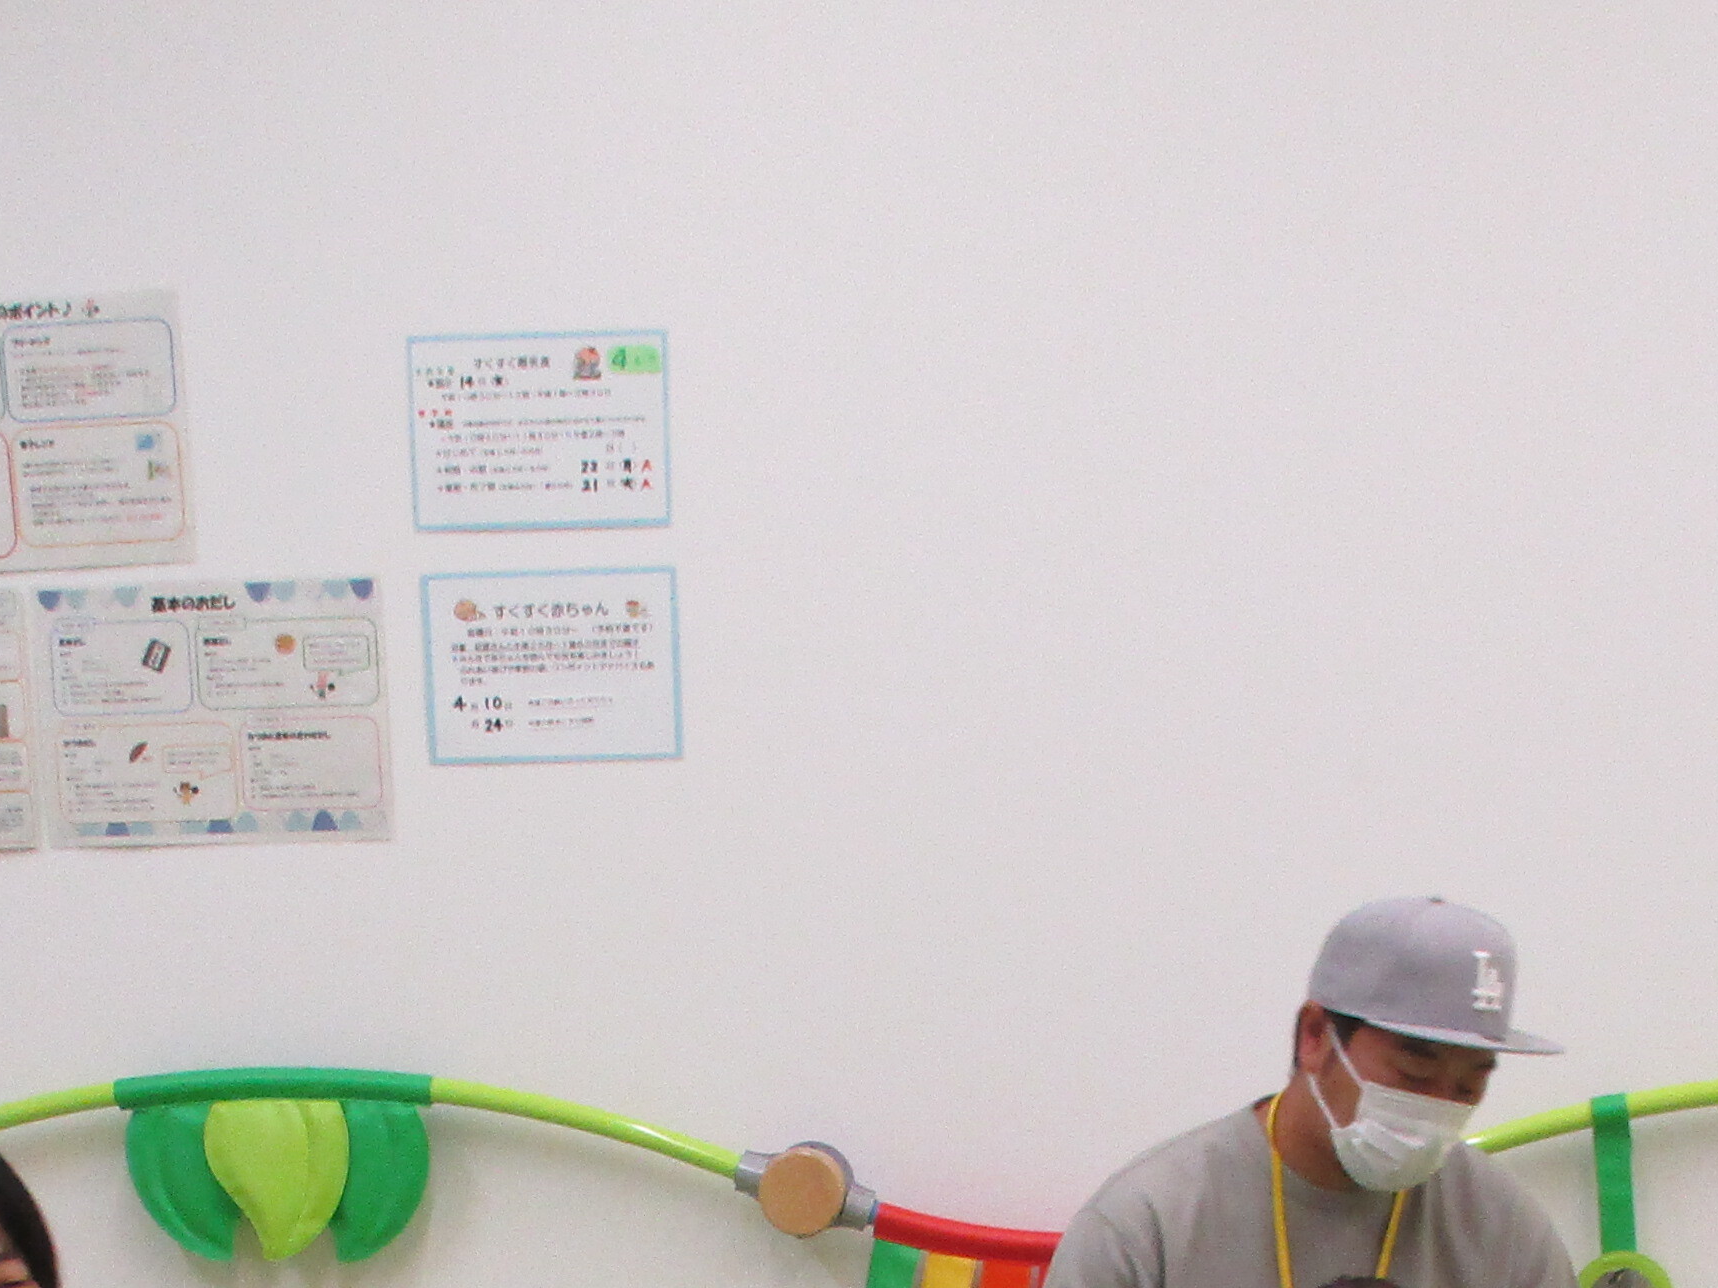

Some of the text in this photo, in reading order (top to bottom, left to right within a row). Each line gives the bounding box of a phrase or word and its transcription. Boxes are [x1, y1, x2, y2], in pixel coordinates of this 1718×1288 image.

[492, 601, 610, 620] すくすく赤ちゃん
